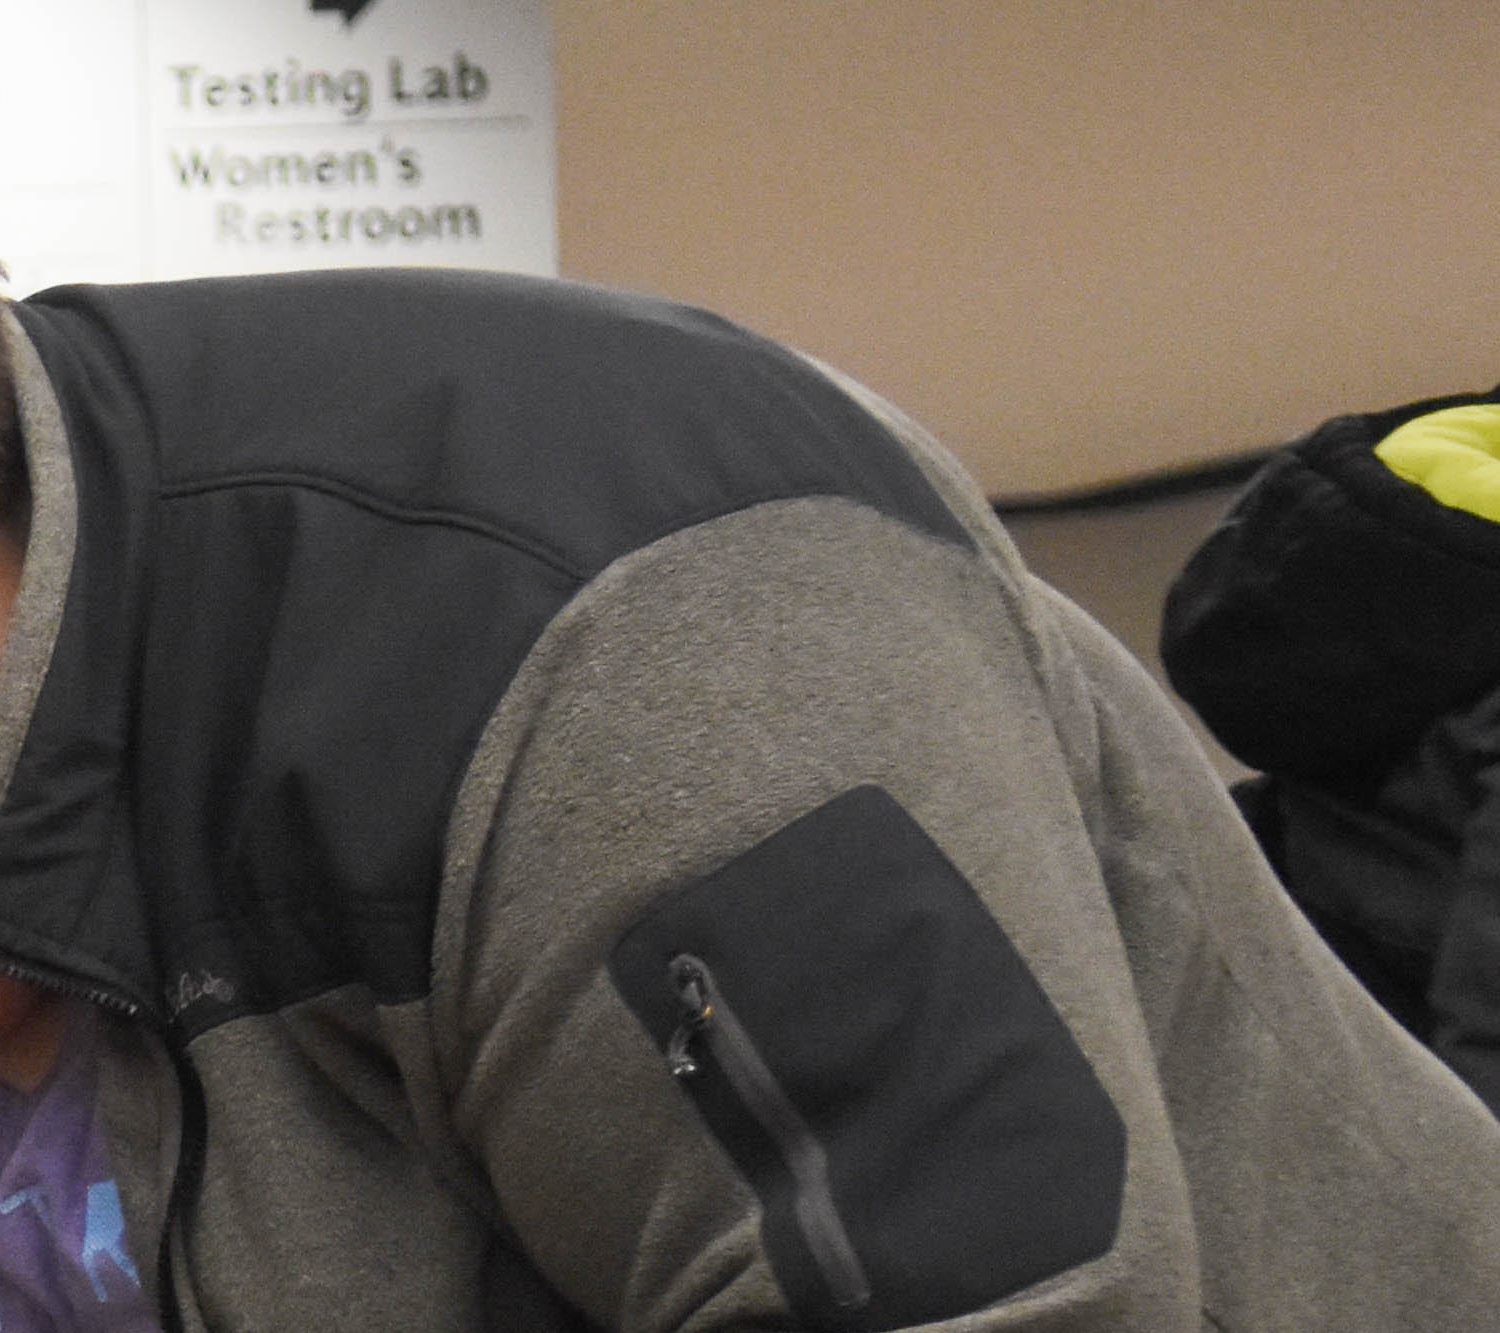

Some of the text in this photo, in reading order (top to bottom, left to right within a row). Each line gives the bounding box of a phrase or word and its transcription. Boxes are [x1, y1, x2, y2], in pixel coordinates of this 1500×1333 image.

[170, 53, 491, 122] Testing Lab
[170, 137, 423, 189] Women's
[216, 202, 484, 246] Restroom
